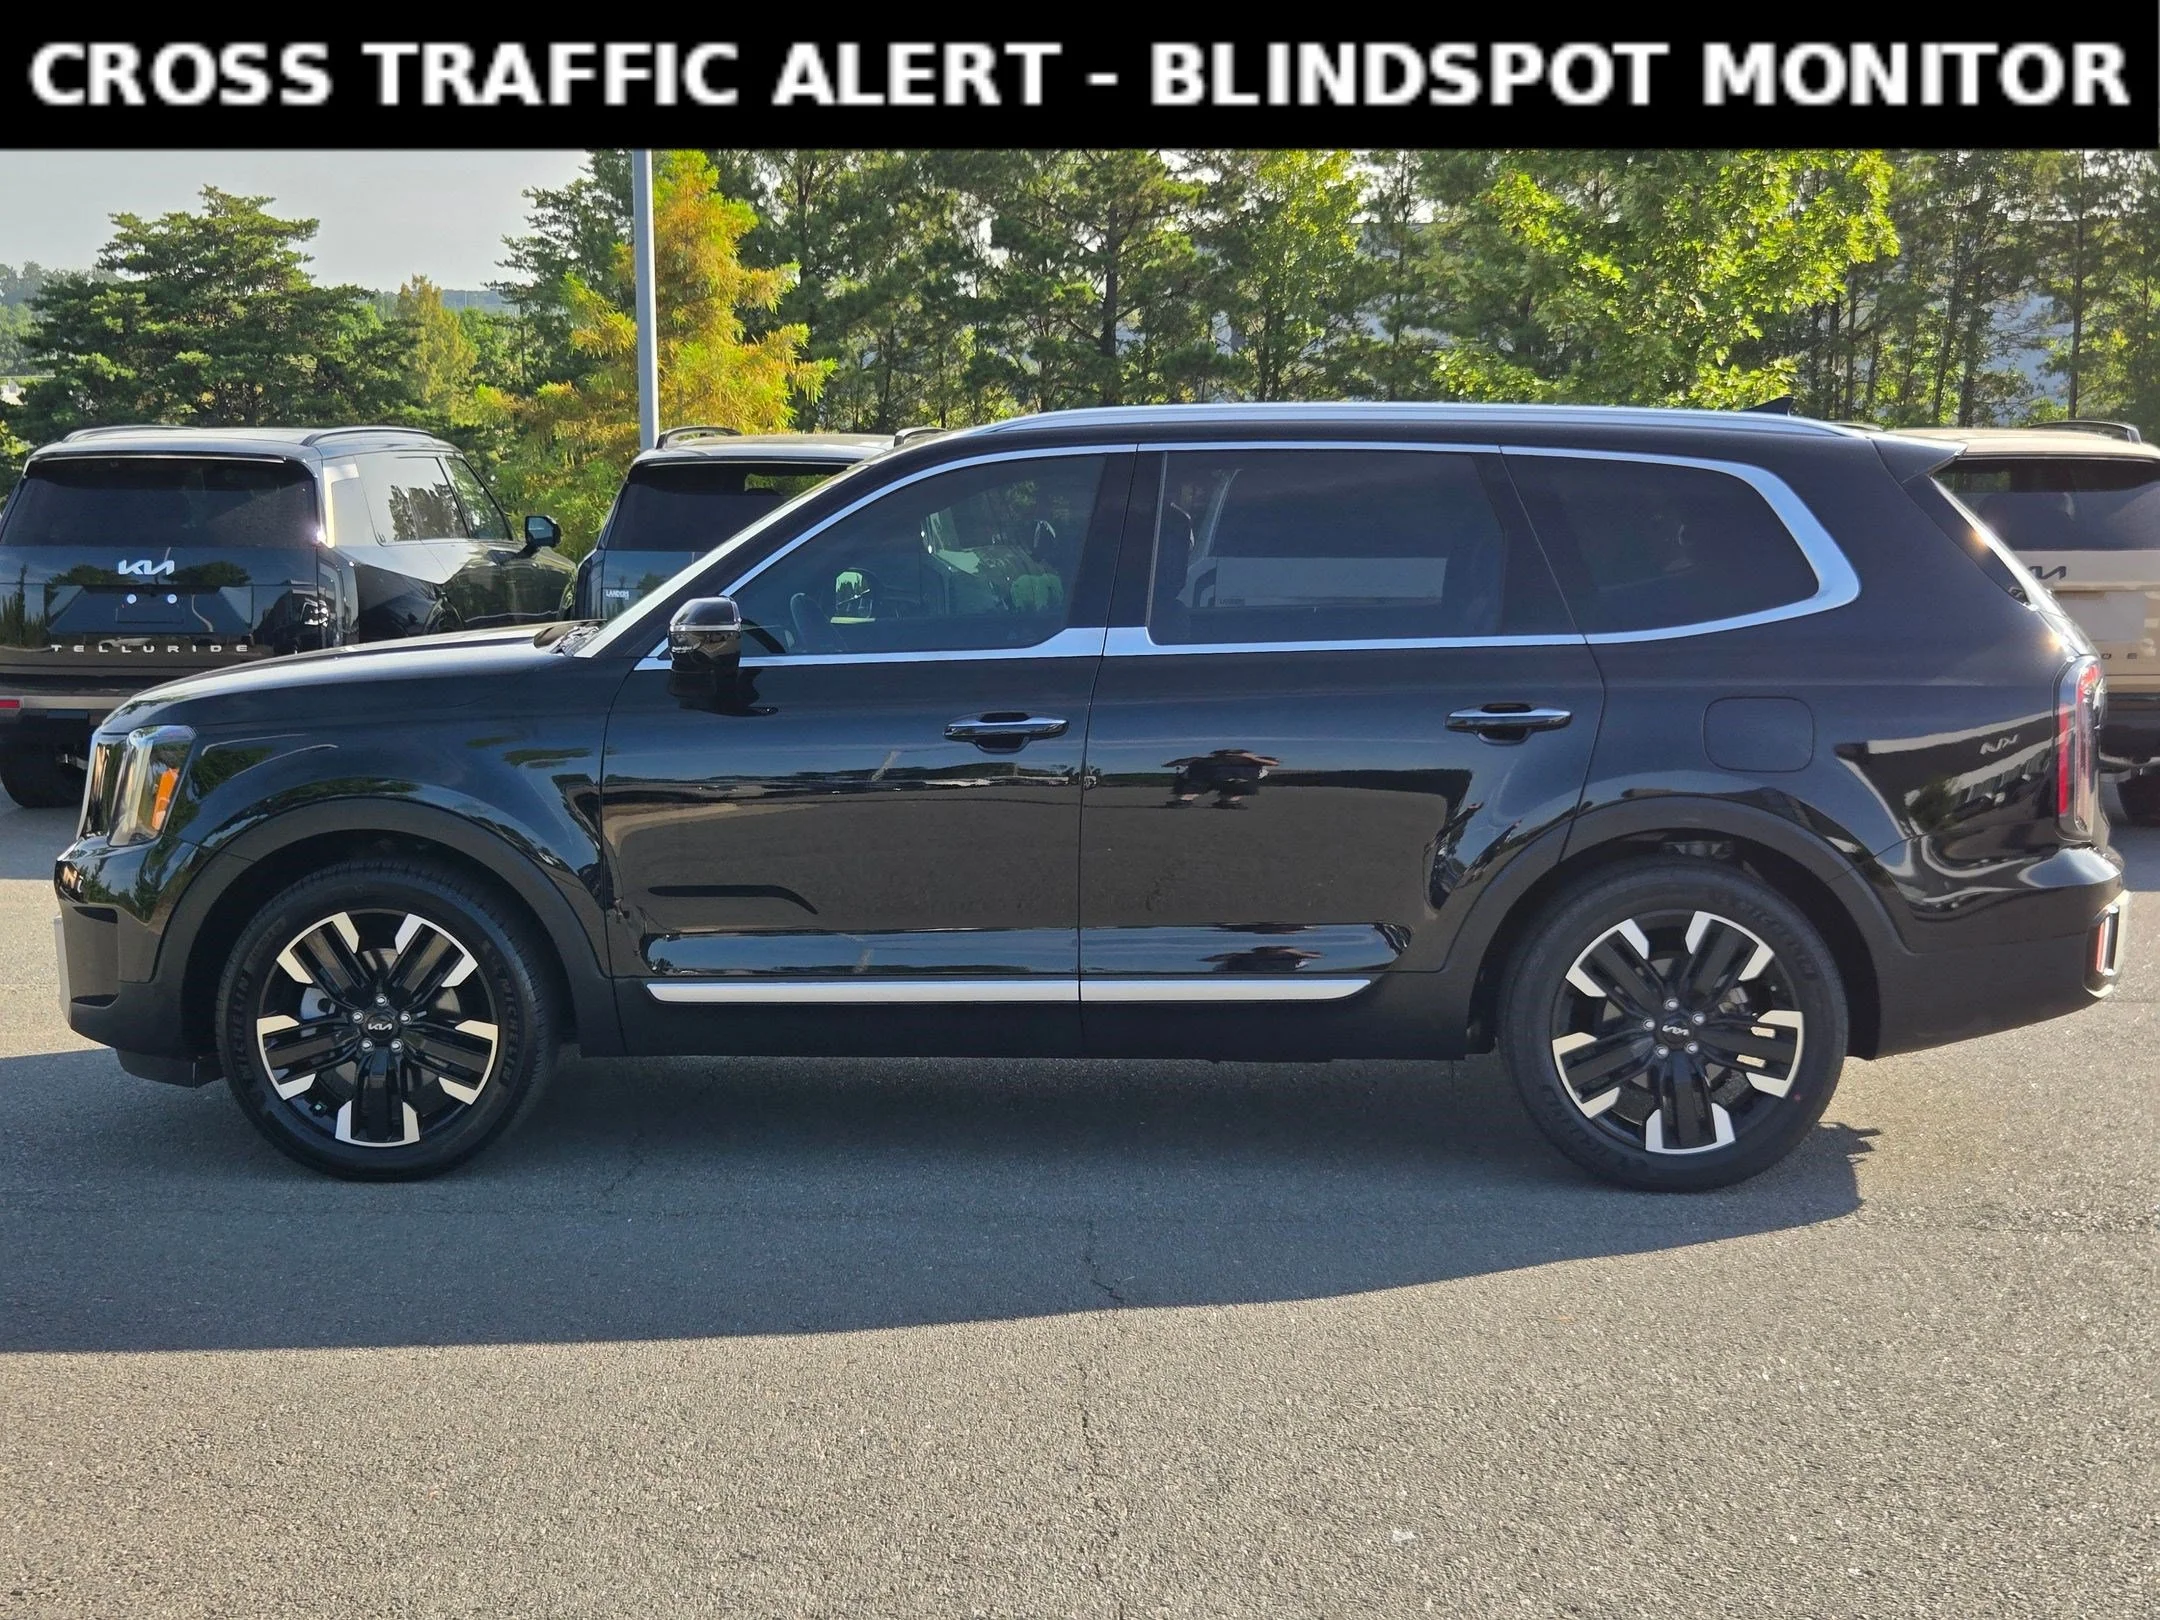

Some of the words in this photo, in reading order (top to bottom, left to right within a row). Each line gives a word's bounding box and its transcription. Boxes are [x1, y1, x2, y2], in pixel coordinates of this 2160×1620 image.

[118, 559, 175, 576] KIA
[50, 643, 249, 654] TELLURIDE
[232, 975, 254, 1080] MICHELIN
[367, 1023, 393, 1031] KIA
[499, 977, 520, 1081] MICHELIN
